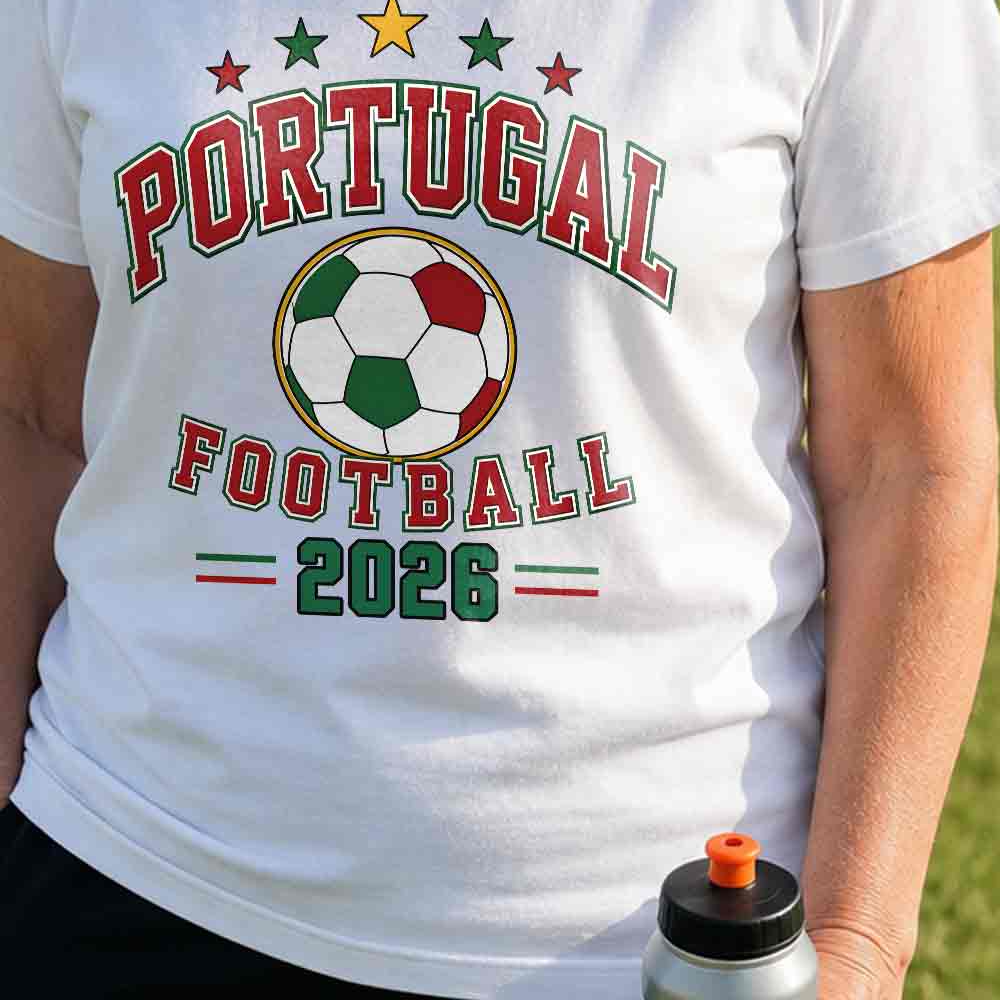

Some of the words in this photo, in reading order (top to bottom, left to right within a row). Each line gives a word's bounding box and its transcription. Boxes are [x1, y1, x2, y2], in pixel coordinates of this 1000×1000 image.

[114, 79, 678, 314] PORTUGAL
[168, 414, 637, 532] FOOTBALL
[296, 537, 499, 623] 2026
